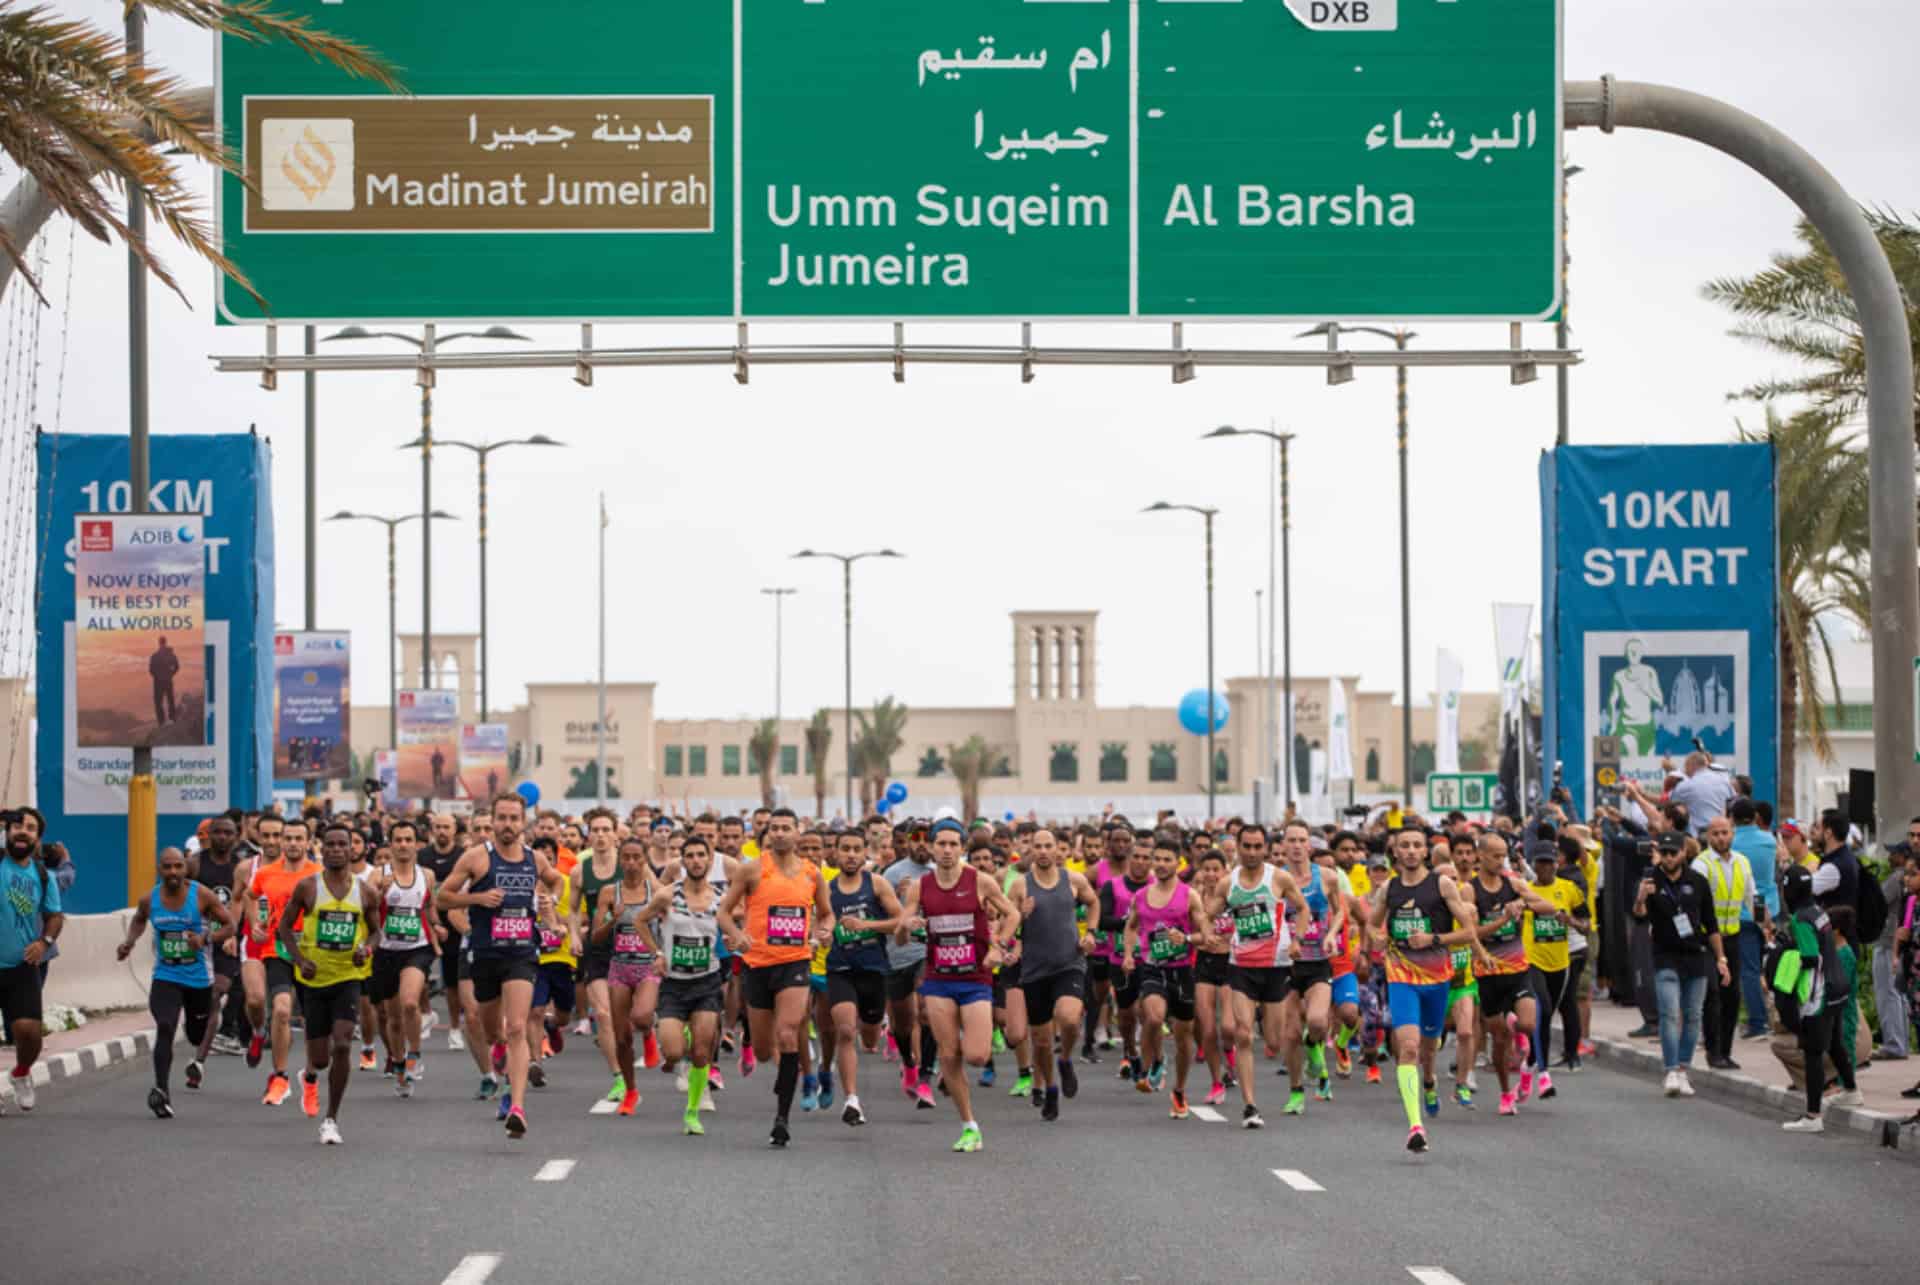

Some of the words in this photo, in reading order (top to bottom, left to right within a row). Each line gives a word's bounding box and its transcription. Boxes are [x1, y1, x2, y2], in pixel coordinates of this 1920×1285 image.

[1310, 2, 1370, 23] DXB
[917, 35, 1047, 88] سقيم
[1069, 29, 1111, 94] ام
[469, 113, 576, 150] جميرا
[592, 113, 693, 150] مدينة
[974, 109, 1109, 161] جميرا
[1365, 108, 1537, 164] البرشاء
[366, 173, 527, 207] Madinat
[539, 172, 707, 207] Jumeirah
[1163, 184, 1218, 227] Al
[1237, 184, 1416, 227] Barsha
[767, 184, 897, 227] Umm
[916, 183, 1109, 235] Suqeim
[767, 242, 970, 286] Jumeira
[80, 480, 213, 517] 10KM
[1598, 490, 1731, 529] 10KM
[130, 529, 173, 544] ADIB
[88, 574, 133, 588] NOW
[138, 574, 193, 590] ENJOY
[1583, 547, 1748, 586] START
[89, 596, 120, 609] THE
[126, 595, 162, 609] BEST
[168, 594, 192, 608] OF
[88, 617, 115, 630] ALL
[120, 616, 193, 630] WORLDS
[78, 758, 132, 770] Standar
[180, 788, 216, 801] 2020
